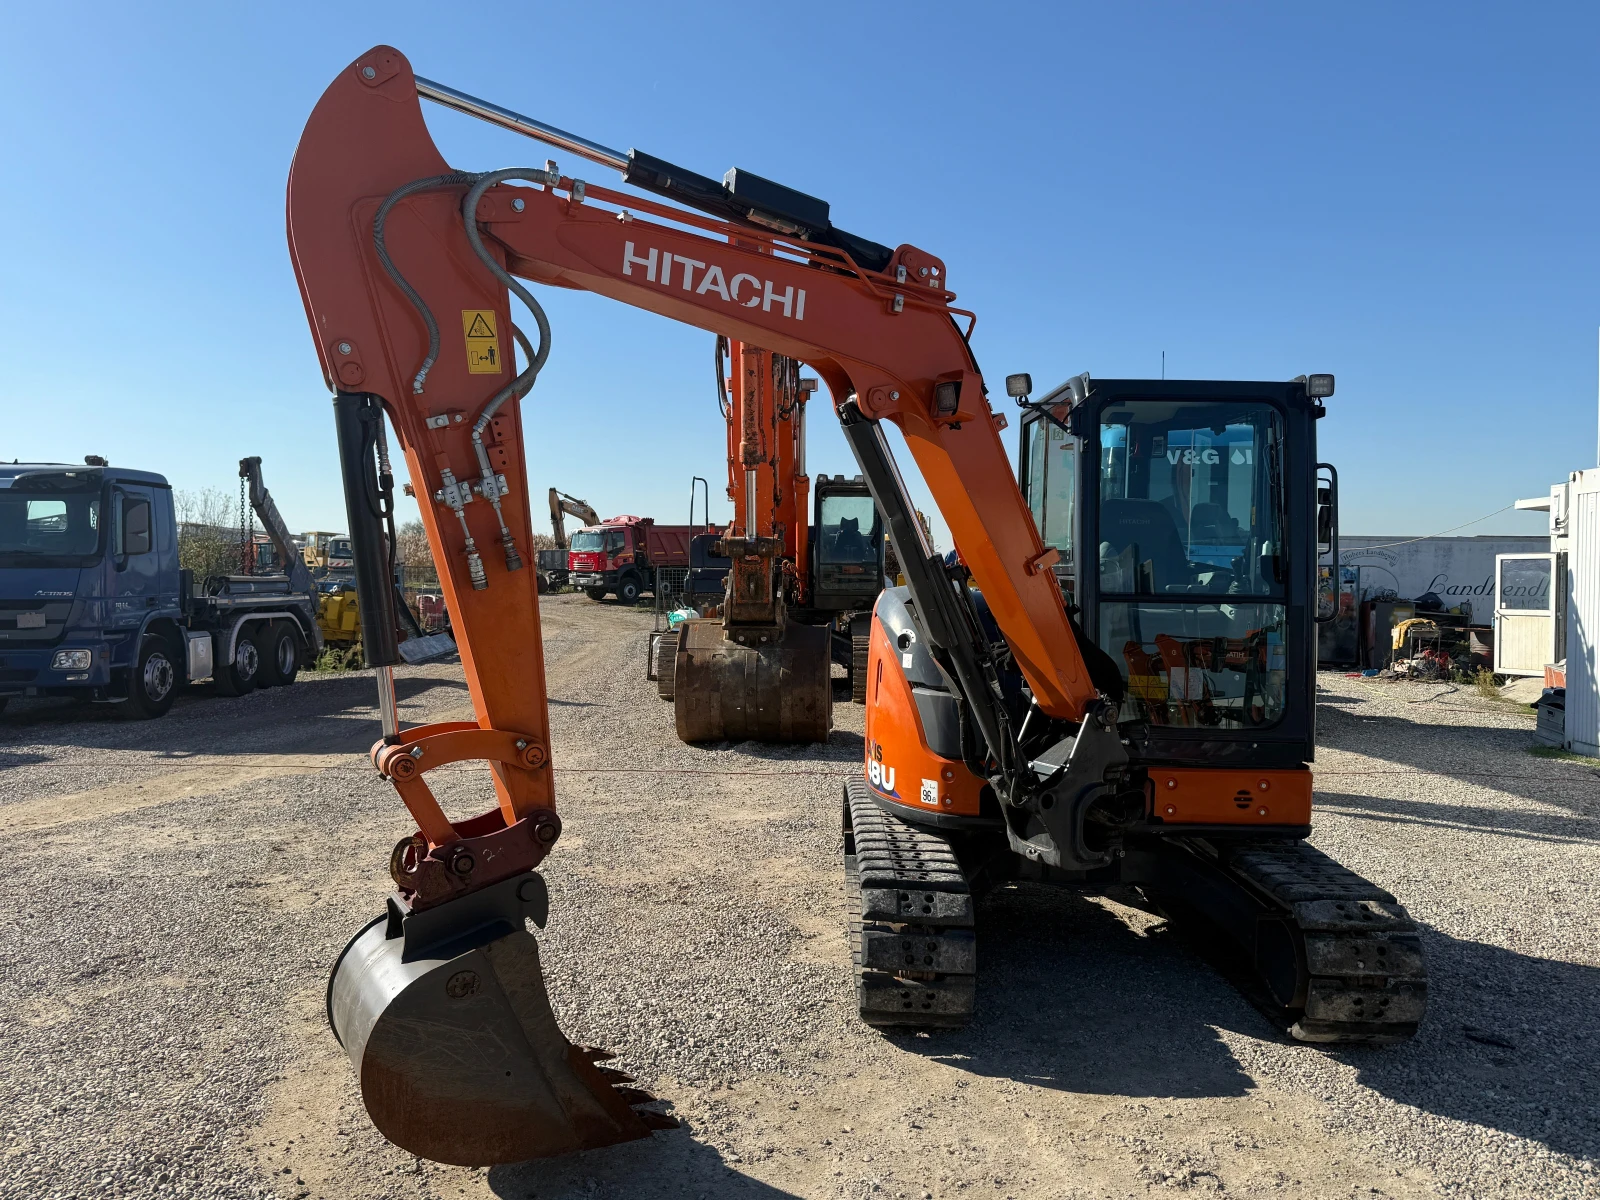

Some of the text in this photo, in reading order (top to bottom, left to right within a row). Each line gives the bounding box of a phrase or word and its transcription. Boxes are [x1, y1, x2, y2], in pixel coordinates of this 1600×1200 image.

[622, 240, 807, 321] HITACHI
[1166, 448, 1220, 465] V&G
[922, 789, 932, 802] 96
